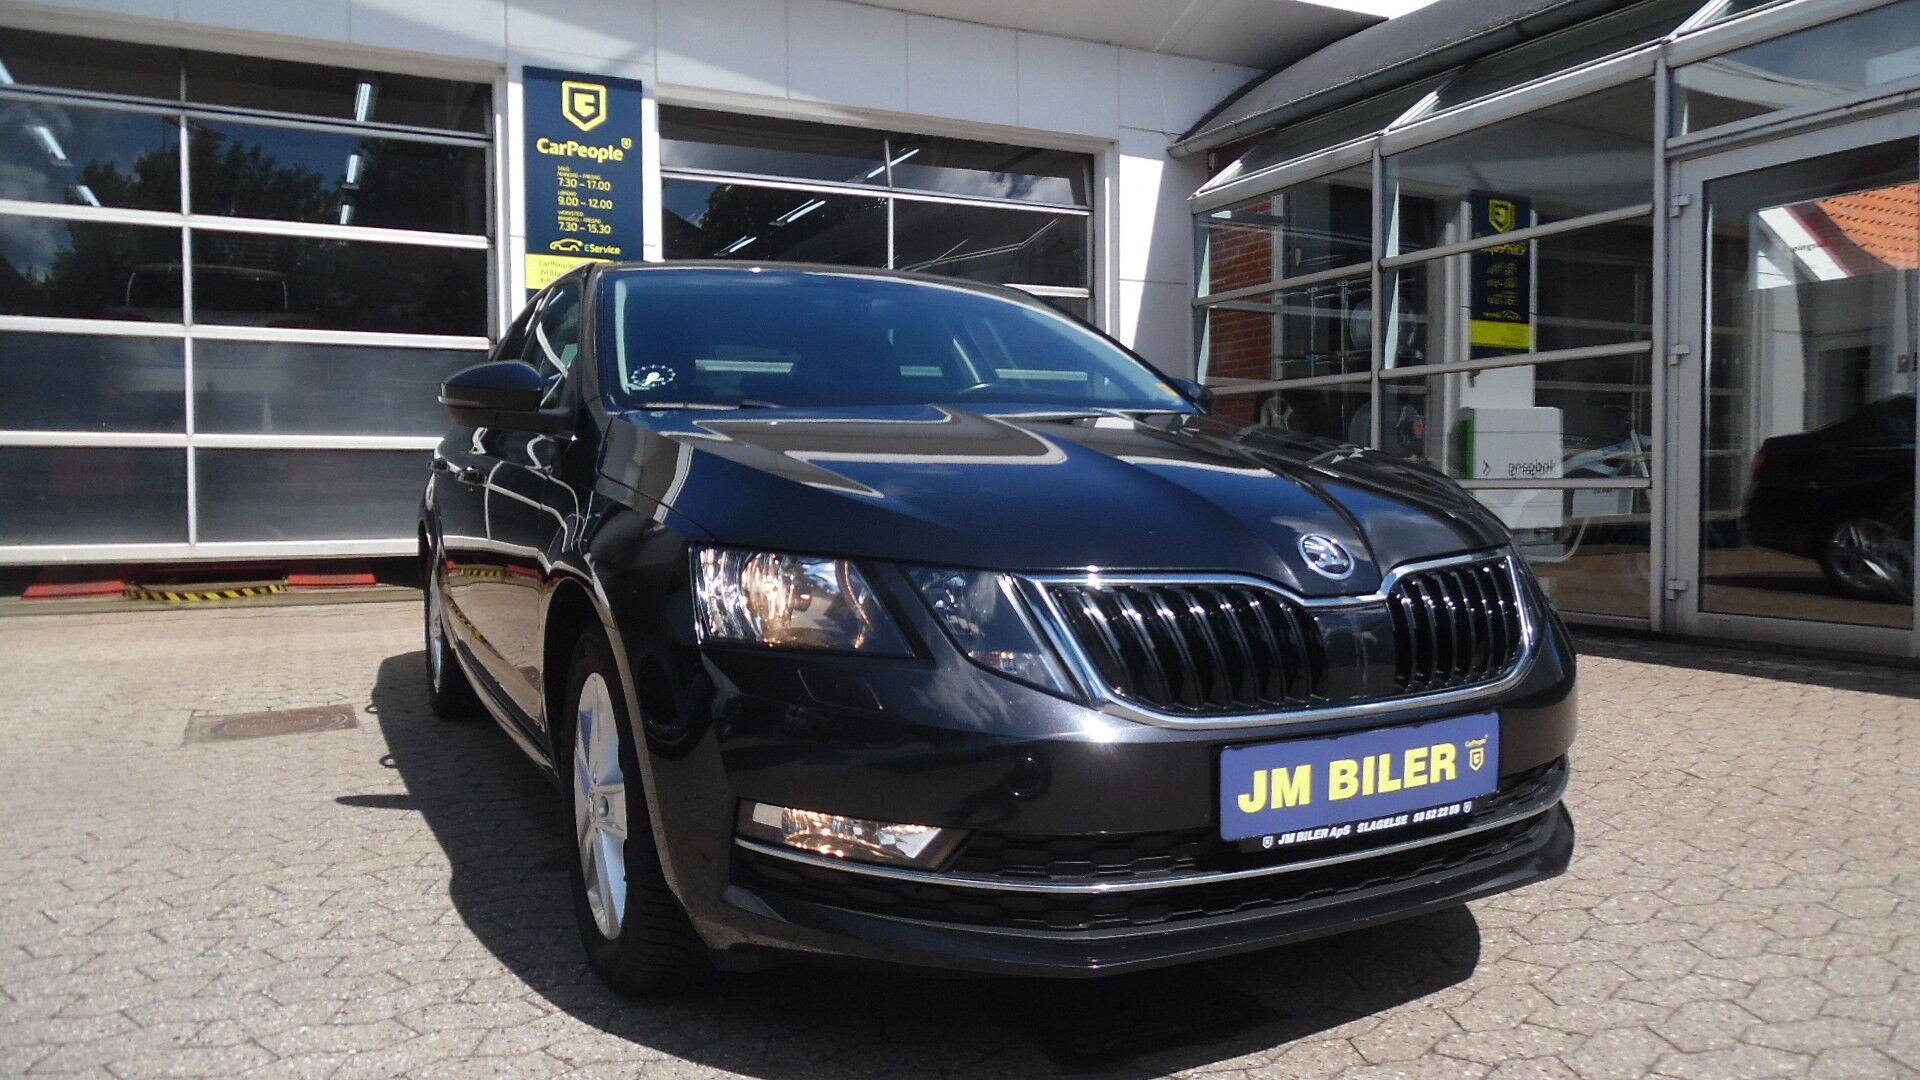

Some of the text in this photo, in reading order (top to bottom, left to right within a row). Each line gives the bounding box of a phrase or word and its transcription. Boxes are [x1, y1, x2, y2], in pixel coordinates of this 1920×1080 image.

[536, 137, 624, 164] CarPeople
[557, 177, 578, 188] 7.30
[587, 179, 611, 191] 17.00
[557, 195, 579, 207] 9.00
[588, 198, 613, 210] 12.00
[558, 221, 578, 232] 7.30
[587, 223, 612, 235] 15.30
[1237, 743, 1458, 814] JM BILER
[1278, 832, 1296, 845] JM
[1296, 828, 1330, 842] BILER
[1329, 824, 1352, 839] ApS
[1356, 814, 1408, 833] SLAGELSE
